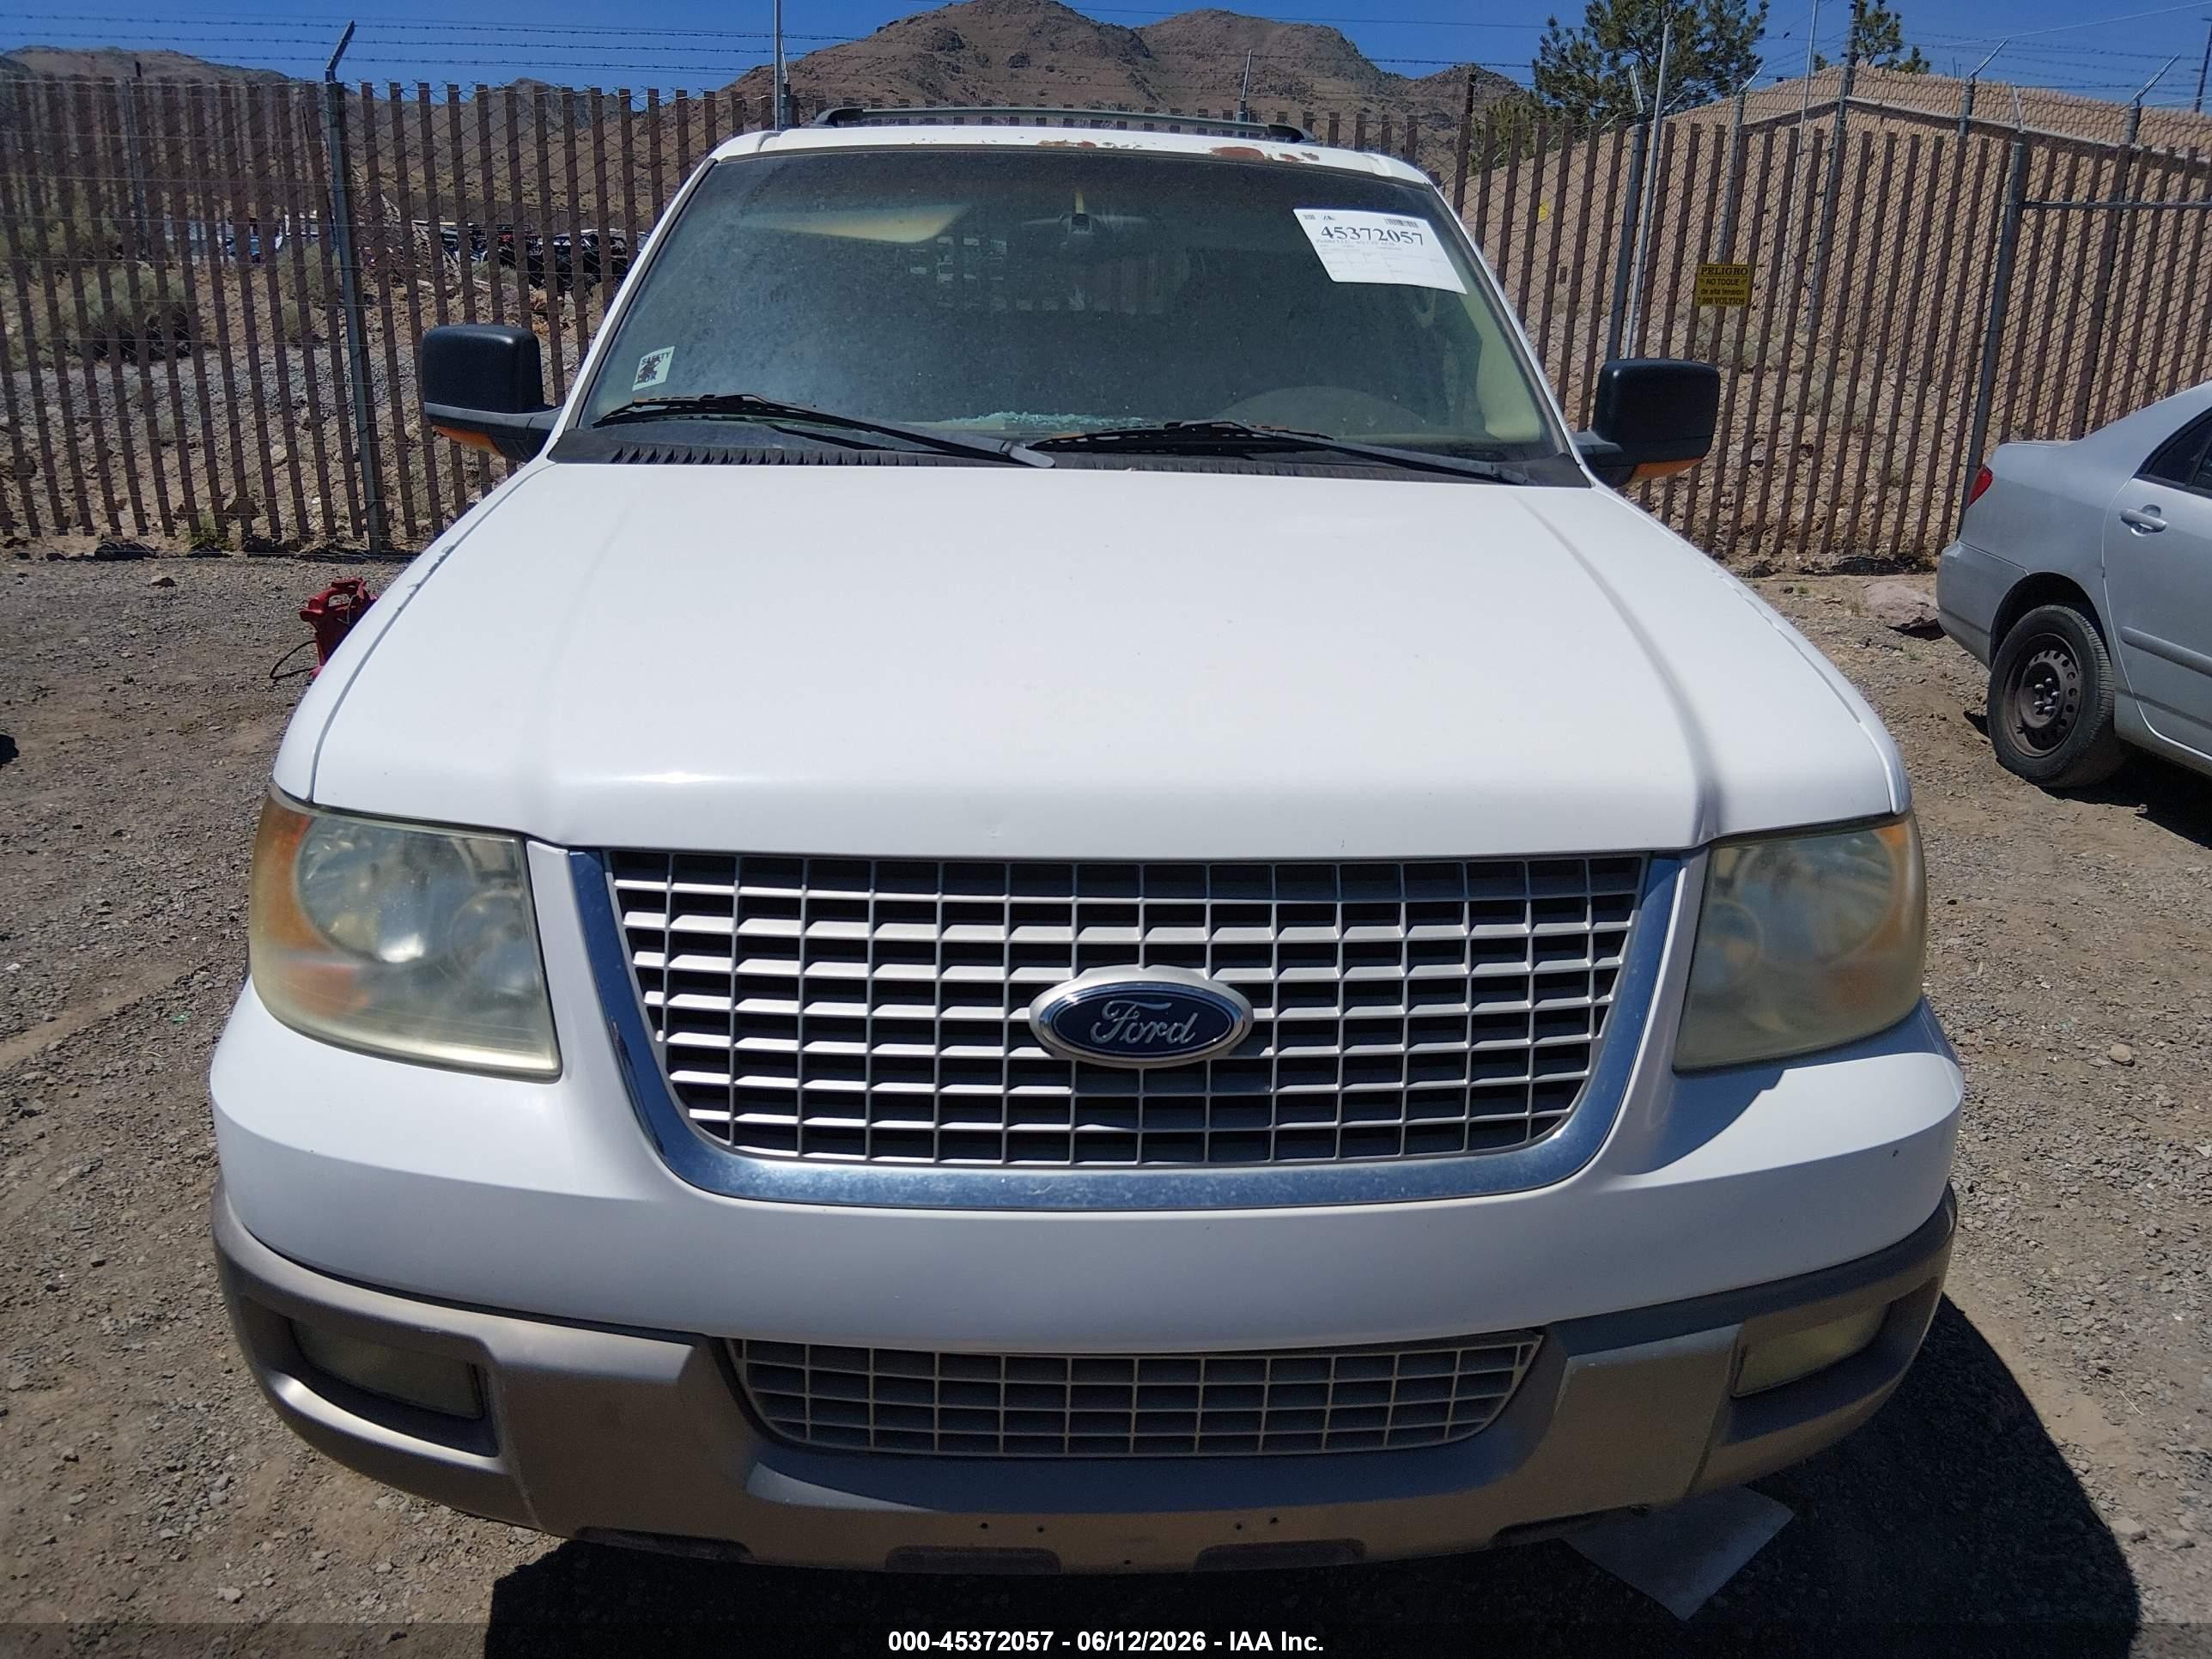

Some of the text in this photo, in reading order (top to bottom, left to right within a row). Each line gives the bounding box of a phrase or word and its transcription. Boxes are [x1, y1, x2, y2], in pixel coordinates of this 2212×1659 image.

[1321, 226, 1424, 246] 45372057
[1701, 267, 1748, 276] PELIGRO
[1090, 1000, 1199, 1044] Ford
